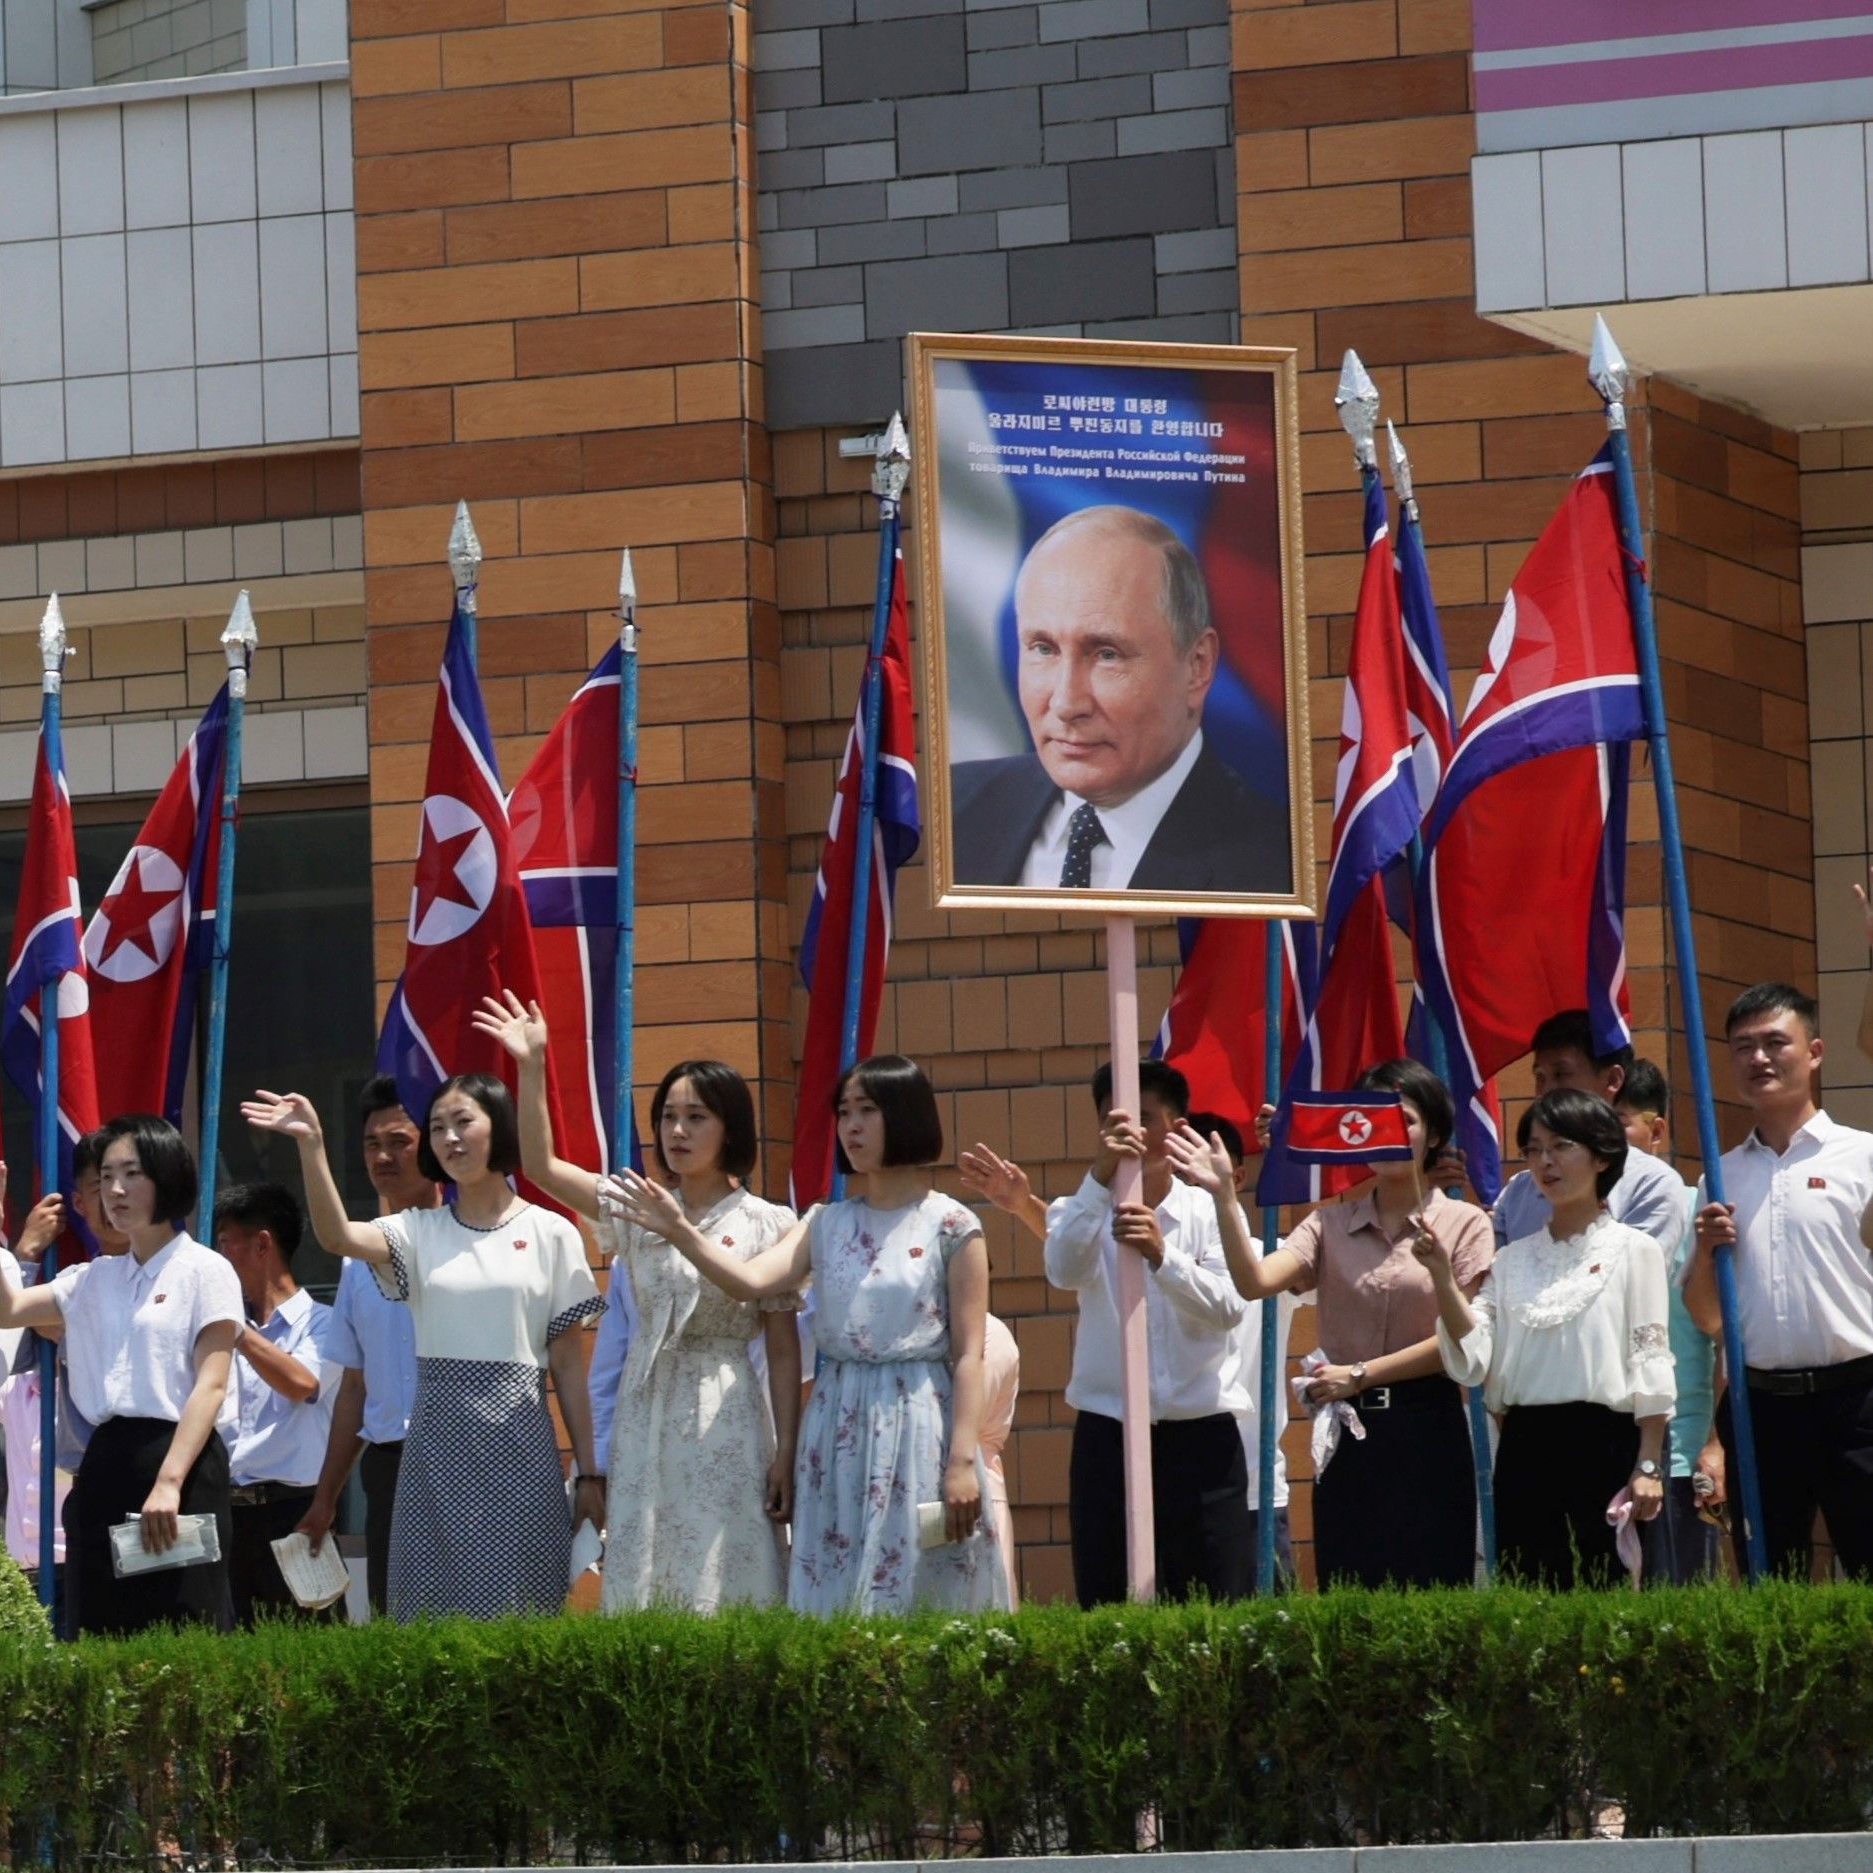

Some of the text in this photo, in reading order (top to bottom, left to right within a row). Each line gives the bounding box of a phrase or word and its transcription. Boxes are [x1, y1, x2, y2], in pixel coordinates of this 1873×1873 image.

[1124, 398, 1168, 415] 대통령
[1151, 420, 1224, 438] 환영합니다
[968, 442, 1245, 465] Приветствуем Президента Российской Федерации
[969, 462, 1246, 484] товарища Владимира Владимировича Путина
